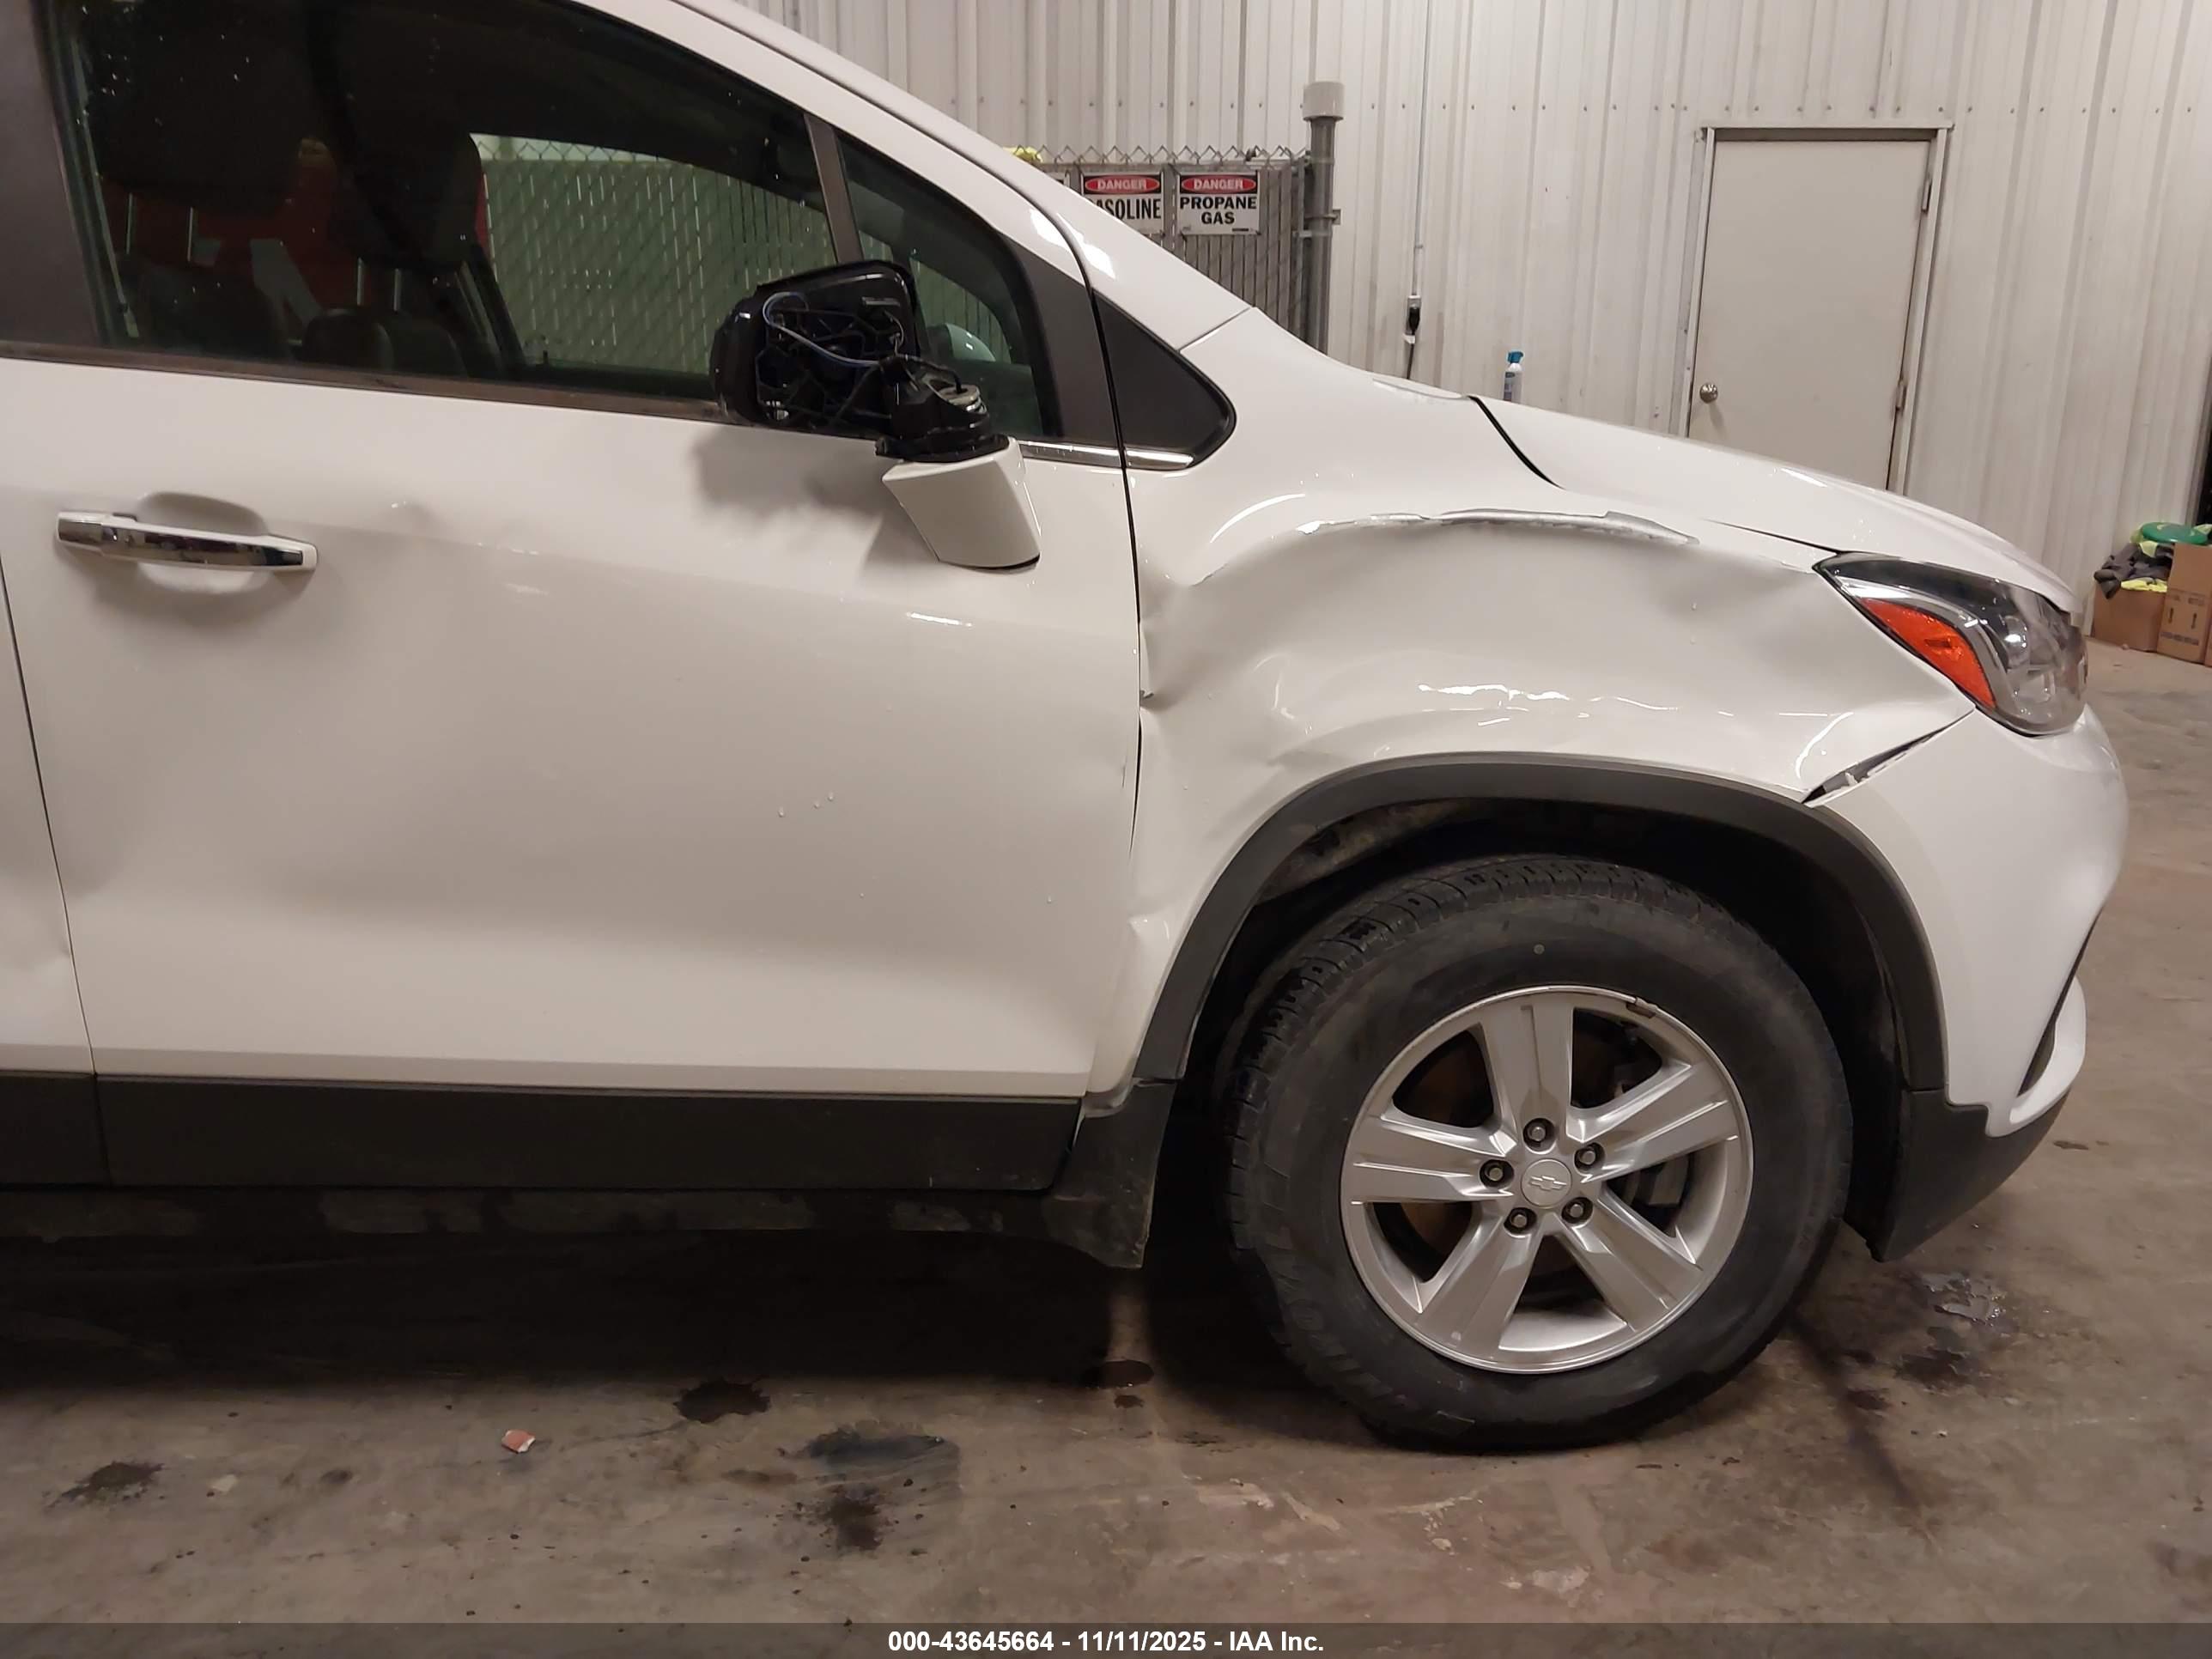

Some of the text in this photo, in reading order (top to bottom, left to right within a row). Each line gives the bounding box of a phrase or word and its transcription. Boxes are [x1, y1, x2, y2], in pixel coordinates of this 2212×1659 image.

[1097, 178, 1146, 191] DANGER
[1194, 178, 1243, 191] DANGER
[1087, 198, 1161, 220] SOLINE
[1179, 196, 1257, 210] PROPANE
[1200, 211, 1236, 225] GAS
